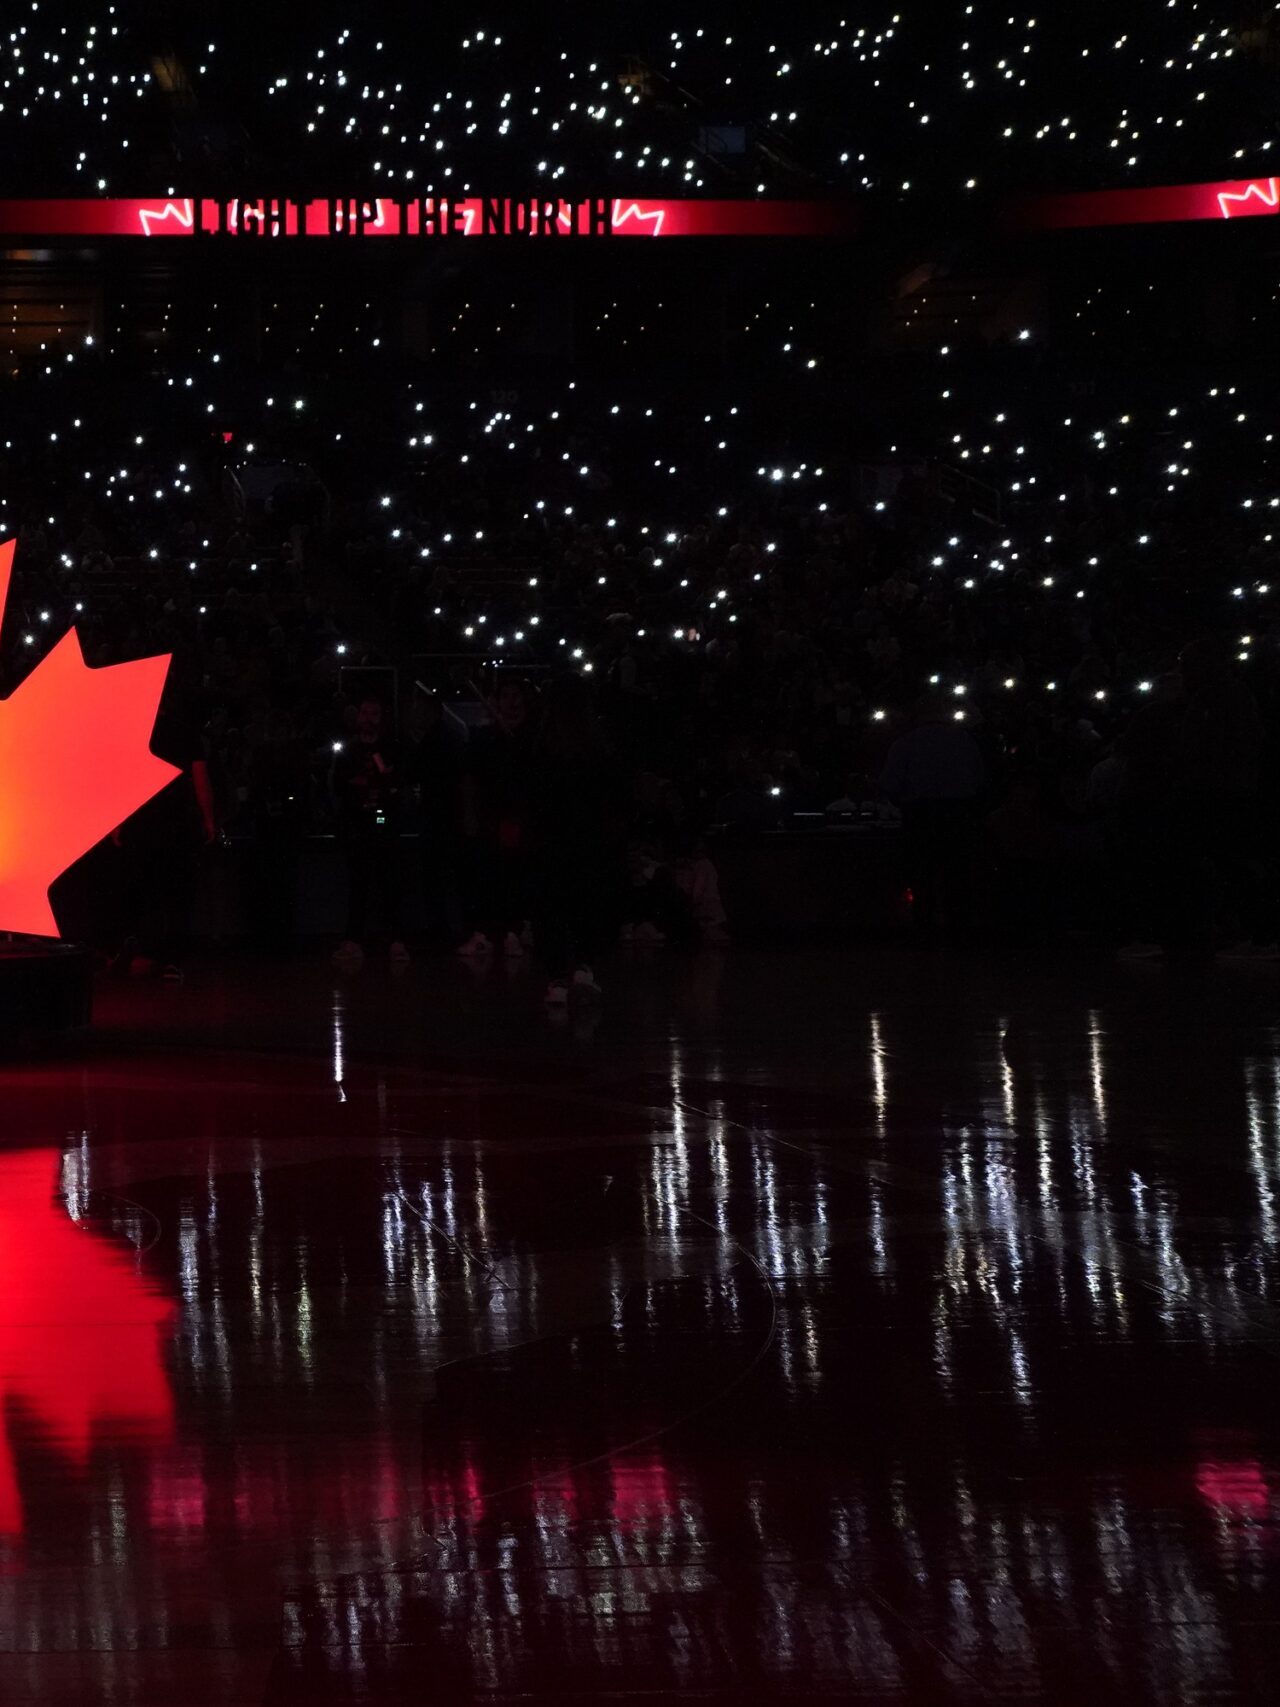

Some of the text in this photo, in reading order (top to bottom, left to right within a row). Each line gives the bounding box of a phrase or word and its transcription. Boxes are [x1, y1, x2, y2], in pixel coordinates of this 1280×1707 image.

[194, 196, 611, 239] LIGHT UP THE NORTH
